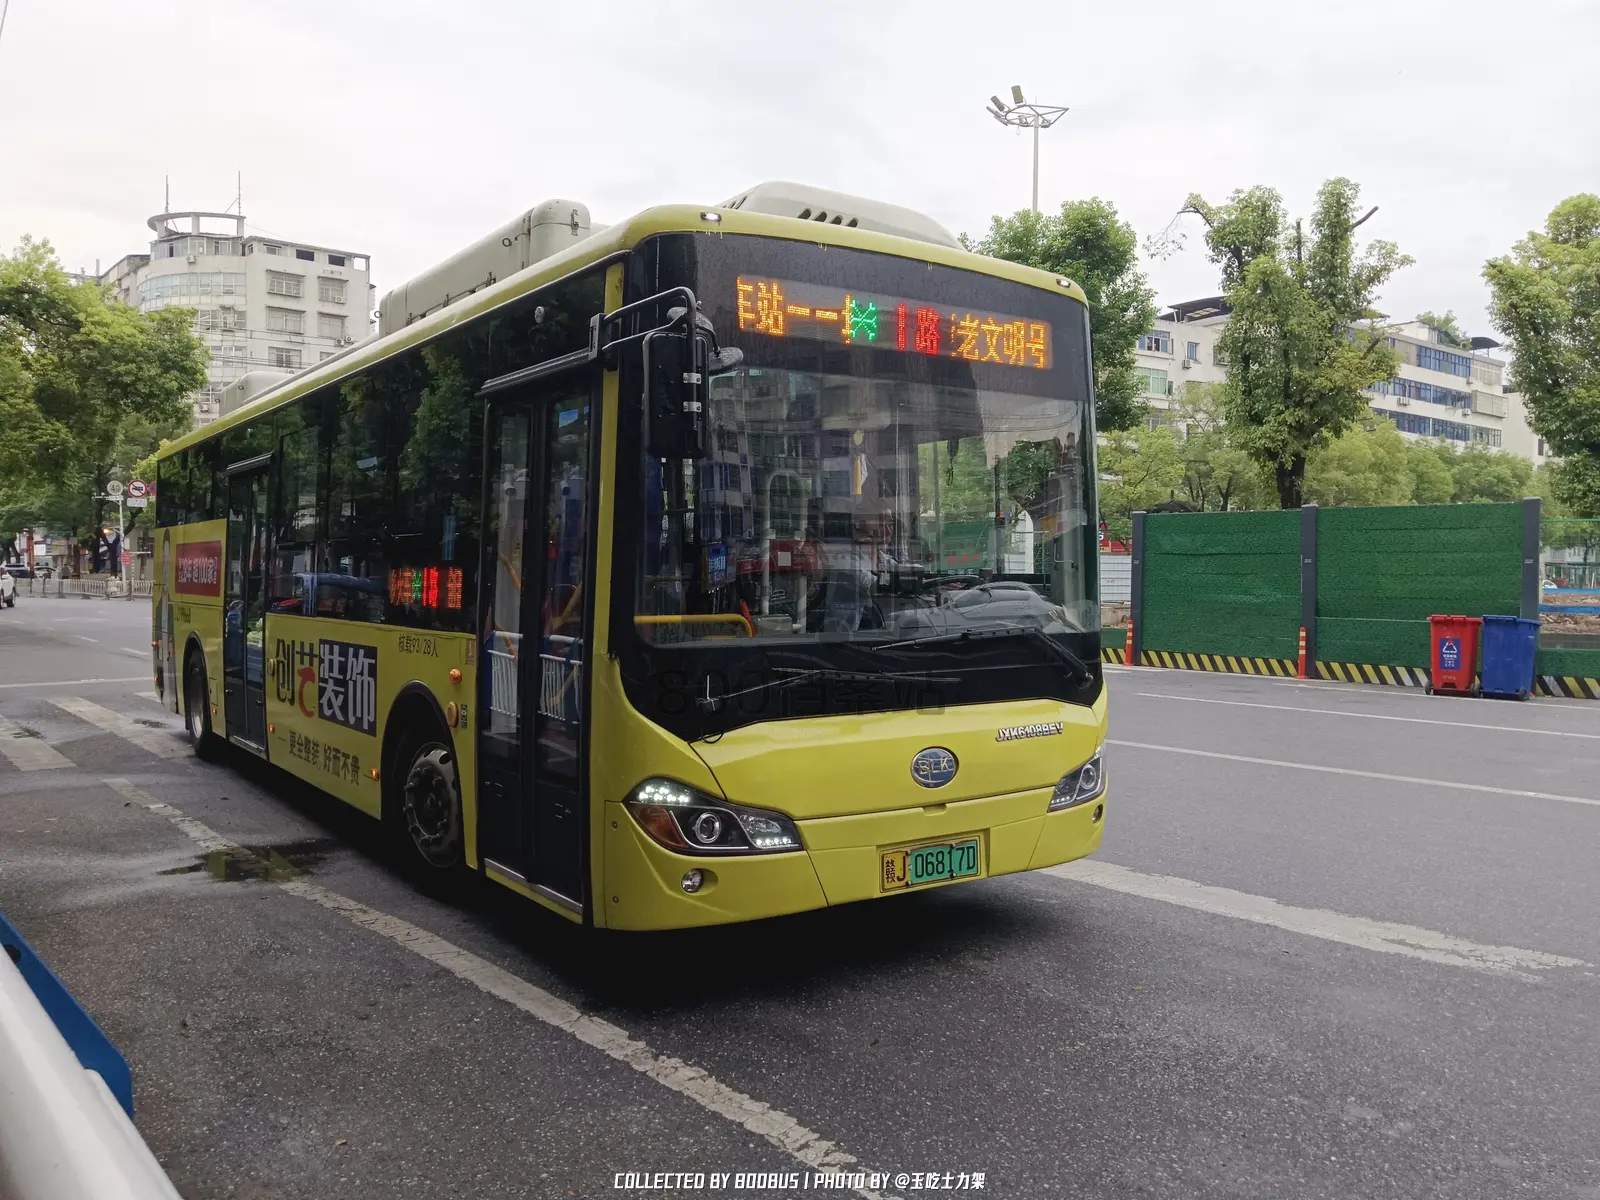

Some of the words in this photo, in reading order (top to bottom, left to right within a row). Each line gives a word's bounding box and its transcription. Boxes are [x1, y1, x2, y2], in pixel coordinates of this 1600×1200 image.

[951, 313, 1046, 369] 老文明号
[275, 637, 377, 731] 创艺装饰
